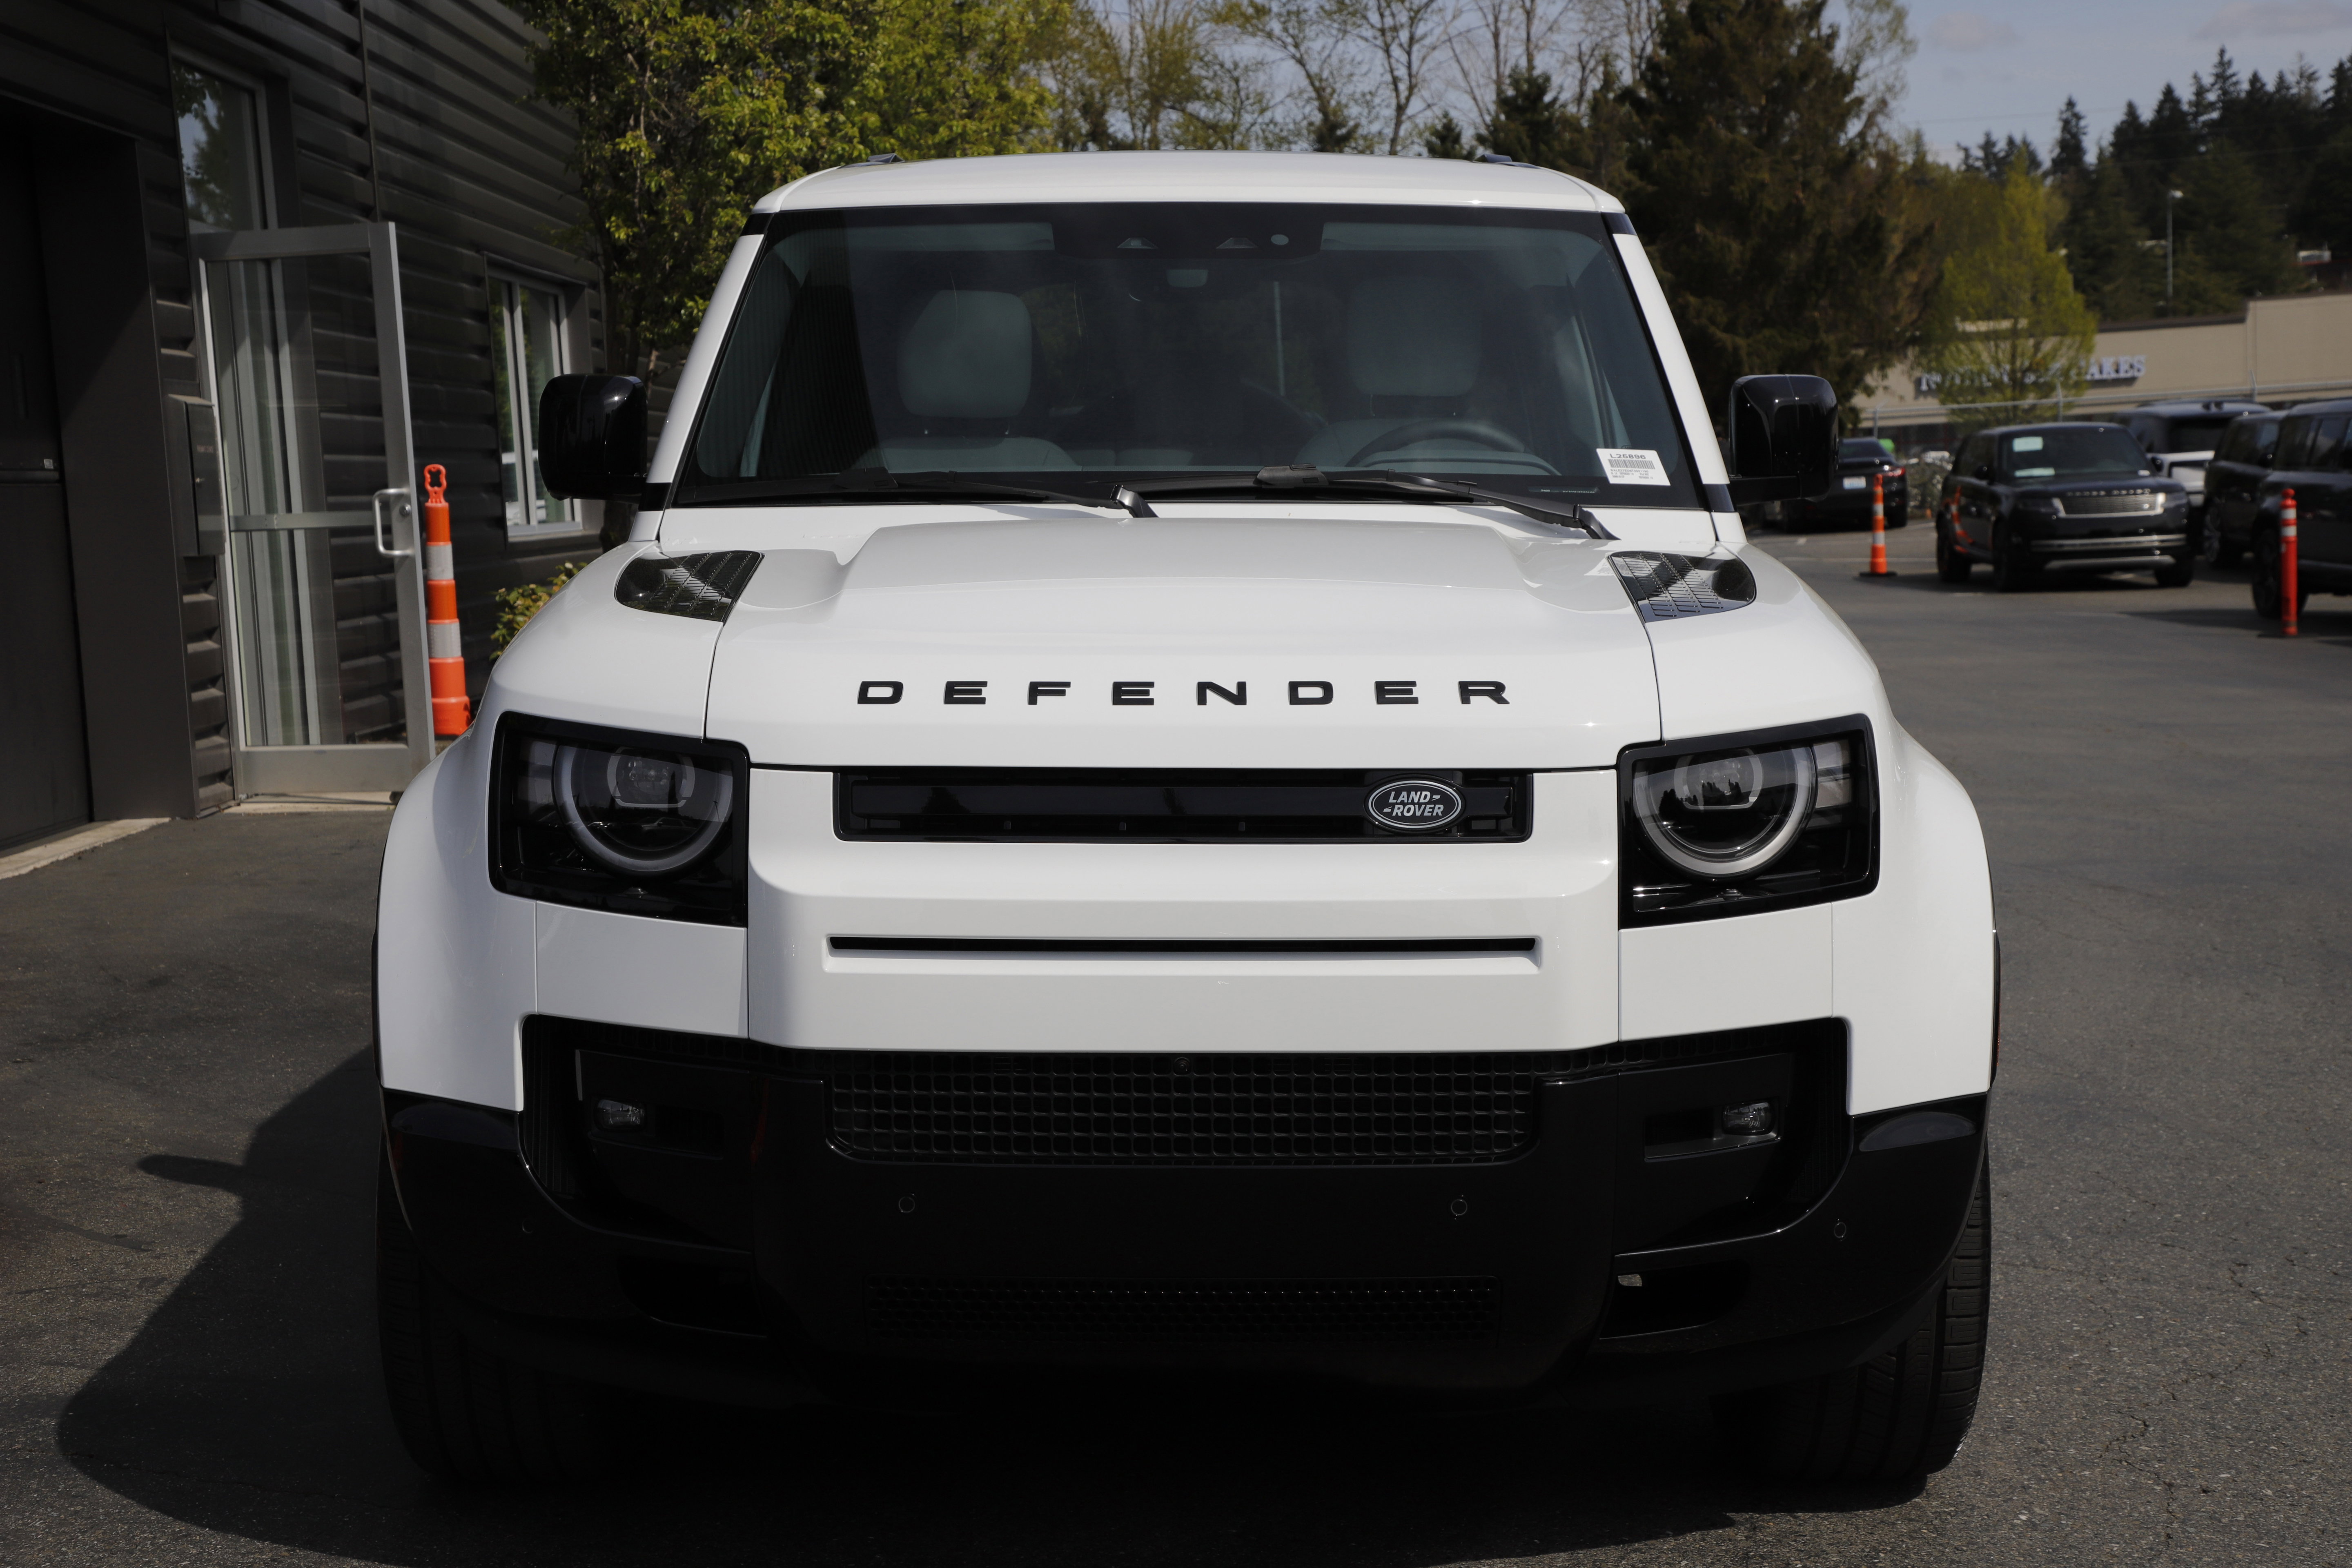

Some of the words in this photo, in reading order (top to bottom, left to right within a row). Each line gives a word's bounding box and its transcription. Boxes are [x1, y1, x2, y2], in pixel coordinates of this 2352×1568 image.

[857, 681, 1510, 706] DEFENDER
[1388, 791, 1431, 803] LAND
[1392, 804, 1444, 816] ROVER
